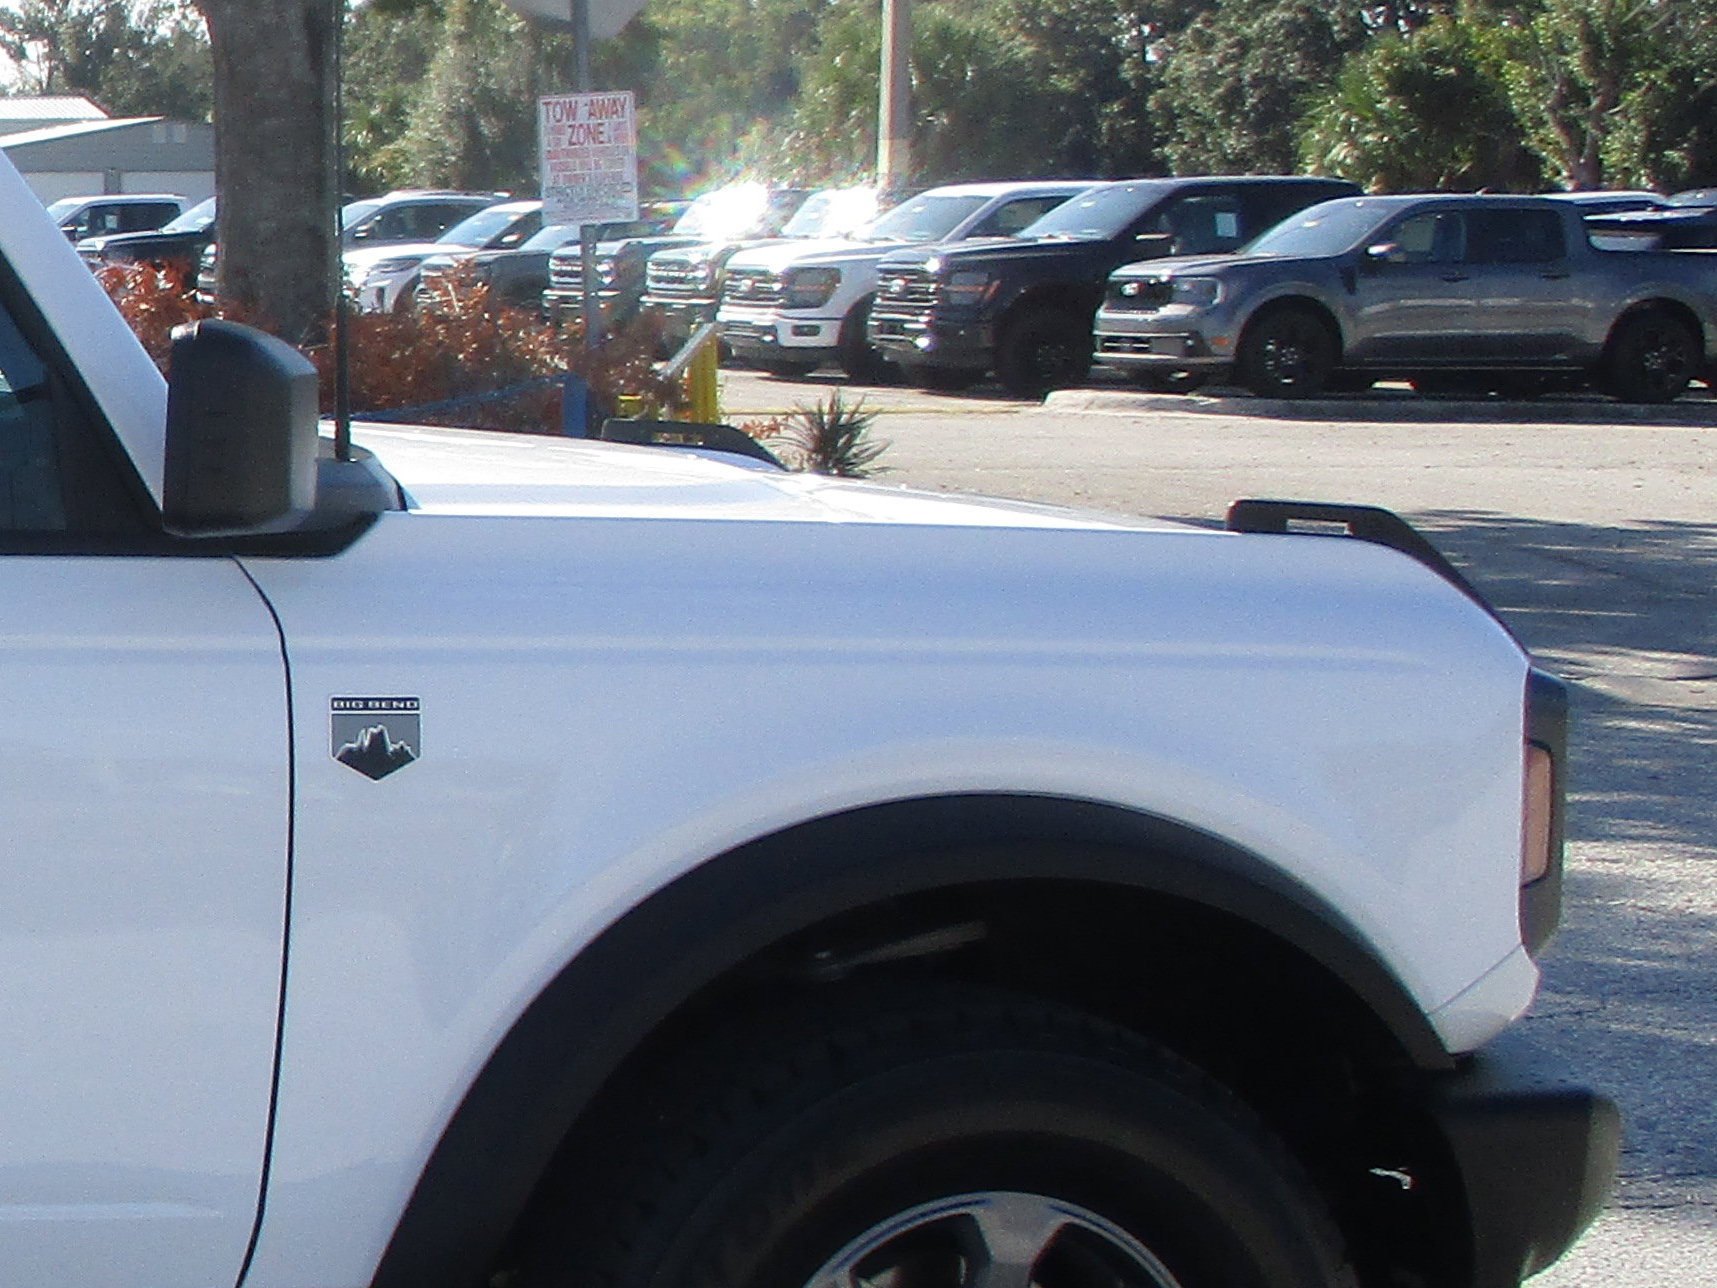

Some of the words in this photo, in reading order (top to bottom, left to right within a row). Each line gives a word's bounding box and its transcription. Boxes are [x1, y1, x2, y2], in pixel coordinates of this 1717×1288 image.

[542, 99, 578, 123] TOW
[567, 122, 606, 146] ZONE
[333, 700, 365, 709] BIG
[368, 700, 419, 709] BEND
